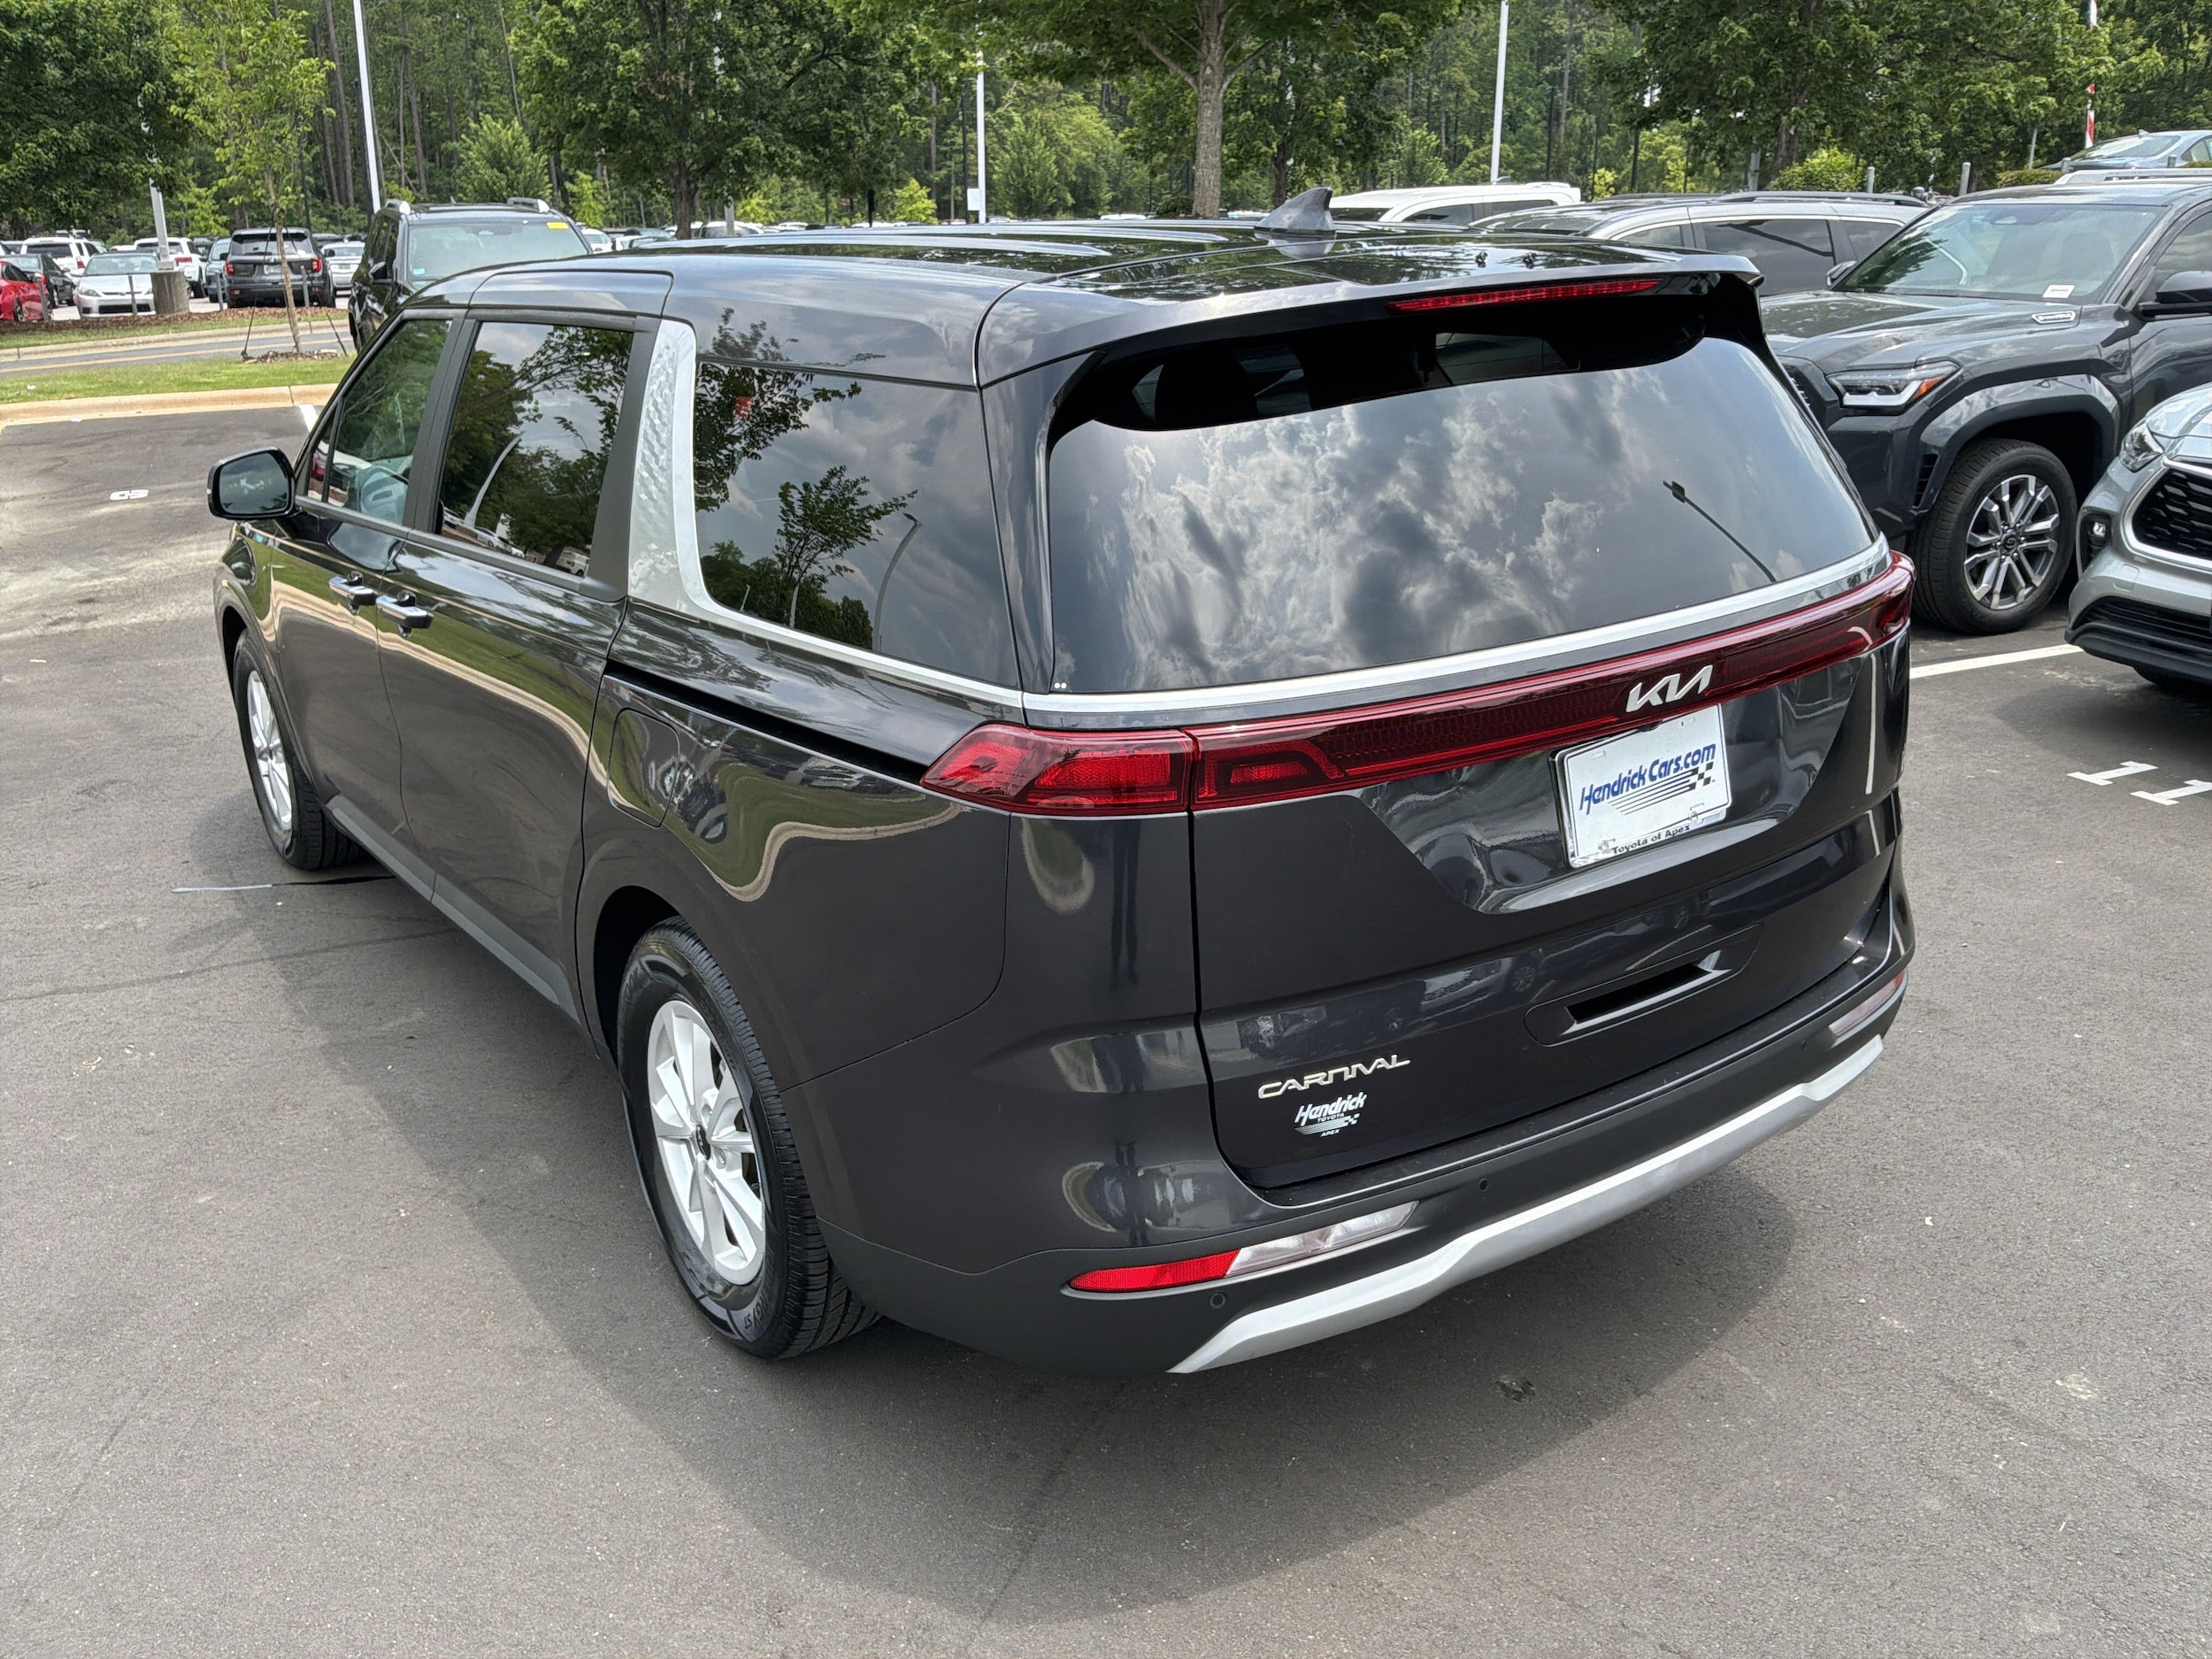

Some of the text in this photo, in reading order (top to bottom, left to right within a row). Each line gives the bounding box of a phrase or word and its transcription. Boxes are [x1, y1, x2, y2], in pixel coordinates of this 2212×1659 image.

[1625, 664, 1713, 712] KIA
[1610, 825, 1691, 855] Toyota of Apex
[1258, 1055, 1410, 1099] CARNIVAL
[1294, 1091, 1368, 1126] Hendrick
[1317, 1112, 1345, 1123] TOYOTA
